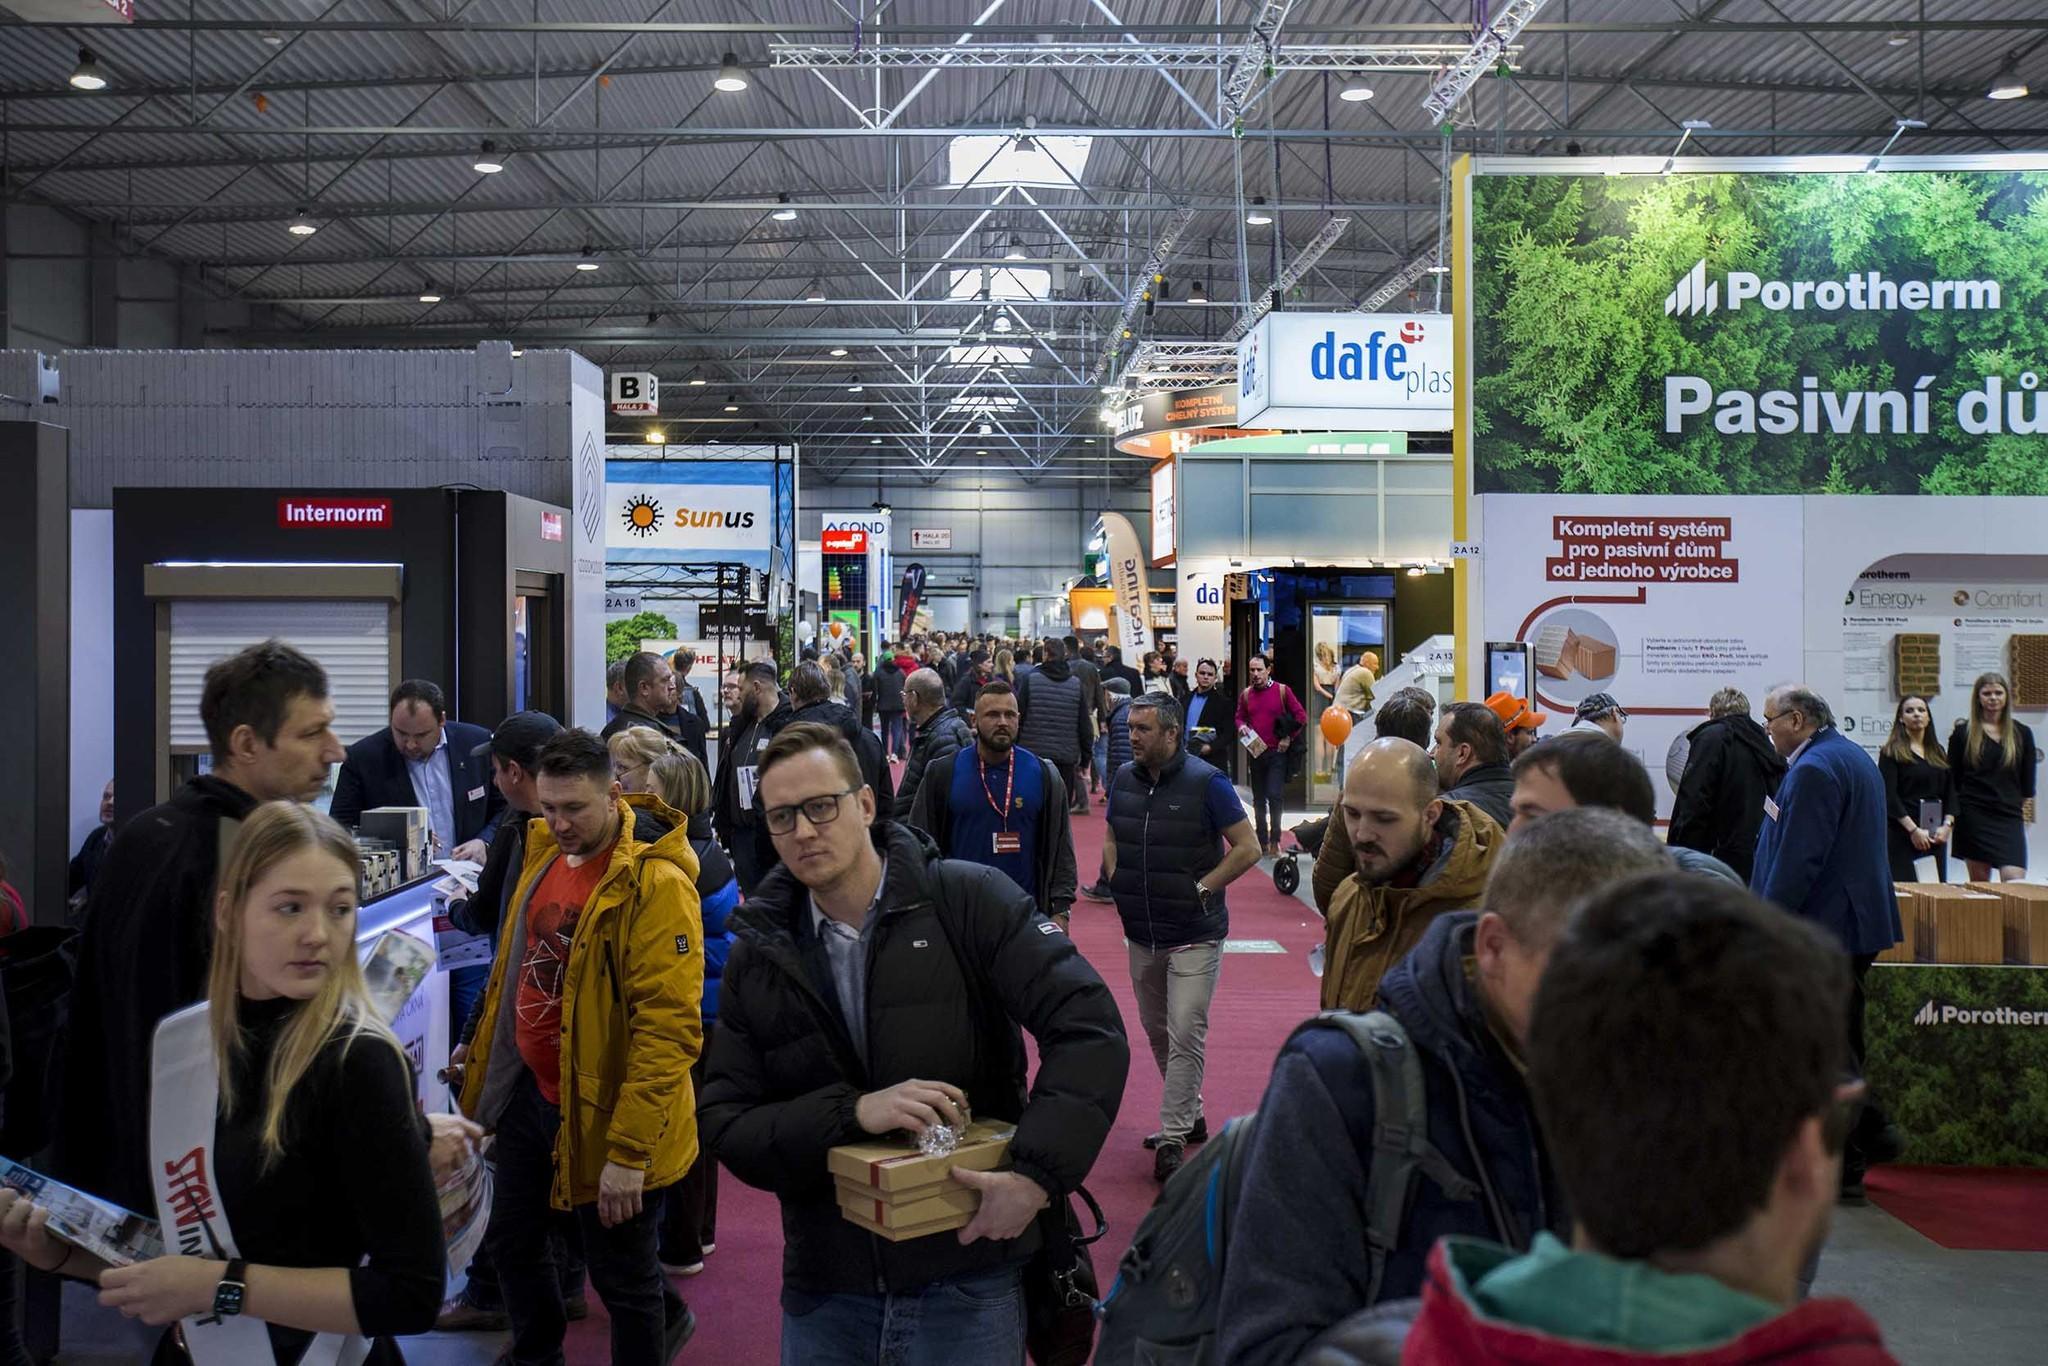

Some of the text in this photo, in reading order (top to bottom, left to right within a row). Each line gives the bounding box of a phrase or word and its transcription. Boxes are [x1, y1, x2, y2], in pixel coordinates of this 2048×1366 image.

[1726, 271, 2000, 311] Porotherm
[1312, 331, 1452, 401] dafe plas
[620, 377, 639, 399] B
[649, 379, 656, 401] B
[1665, 372, 2048, 435] Pasivní dů
[286, 503, 383, 521] Internorm
[674, 508, 755, 528] Sunus
[1559, 520, 1726, 540] Kompletní systém
[1568, 540, 1715, 559] pro pasivní dům
[1552, 562, 1733, 581] od jednoho výrobce
[1859, 569, 1911, 580] orotherm
[605, 598, 636, 607] 2 A 18
[1196, 583, 1224, 604] da
[1860, 588, 1927, 610] Energy+
[1974, 589, 2043, 609] Comfort
[1860, 715, 1893, 733] Ene
